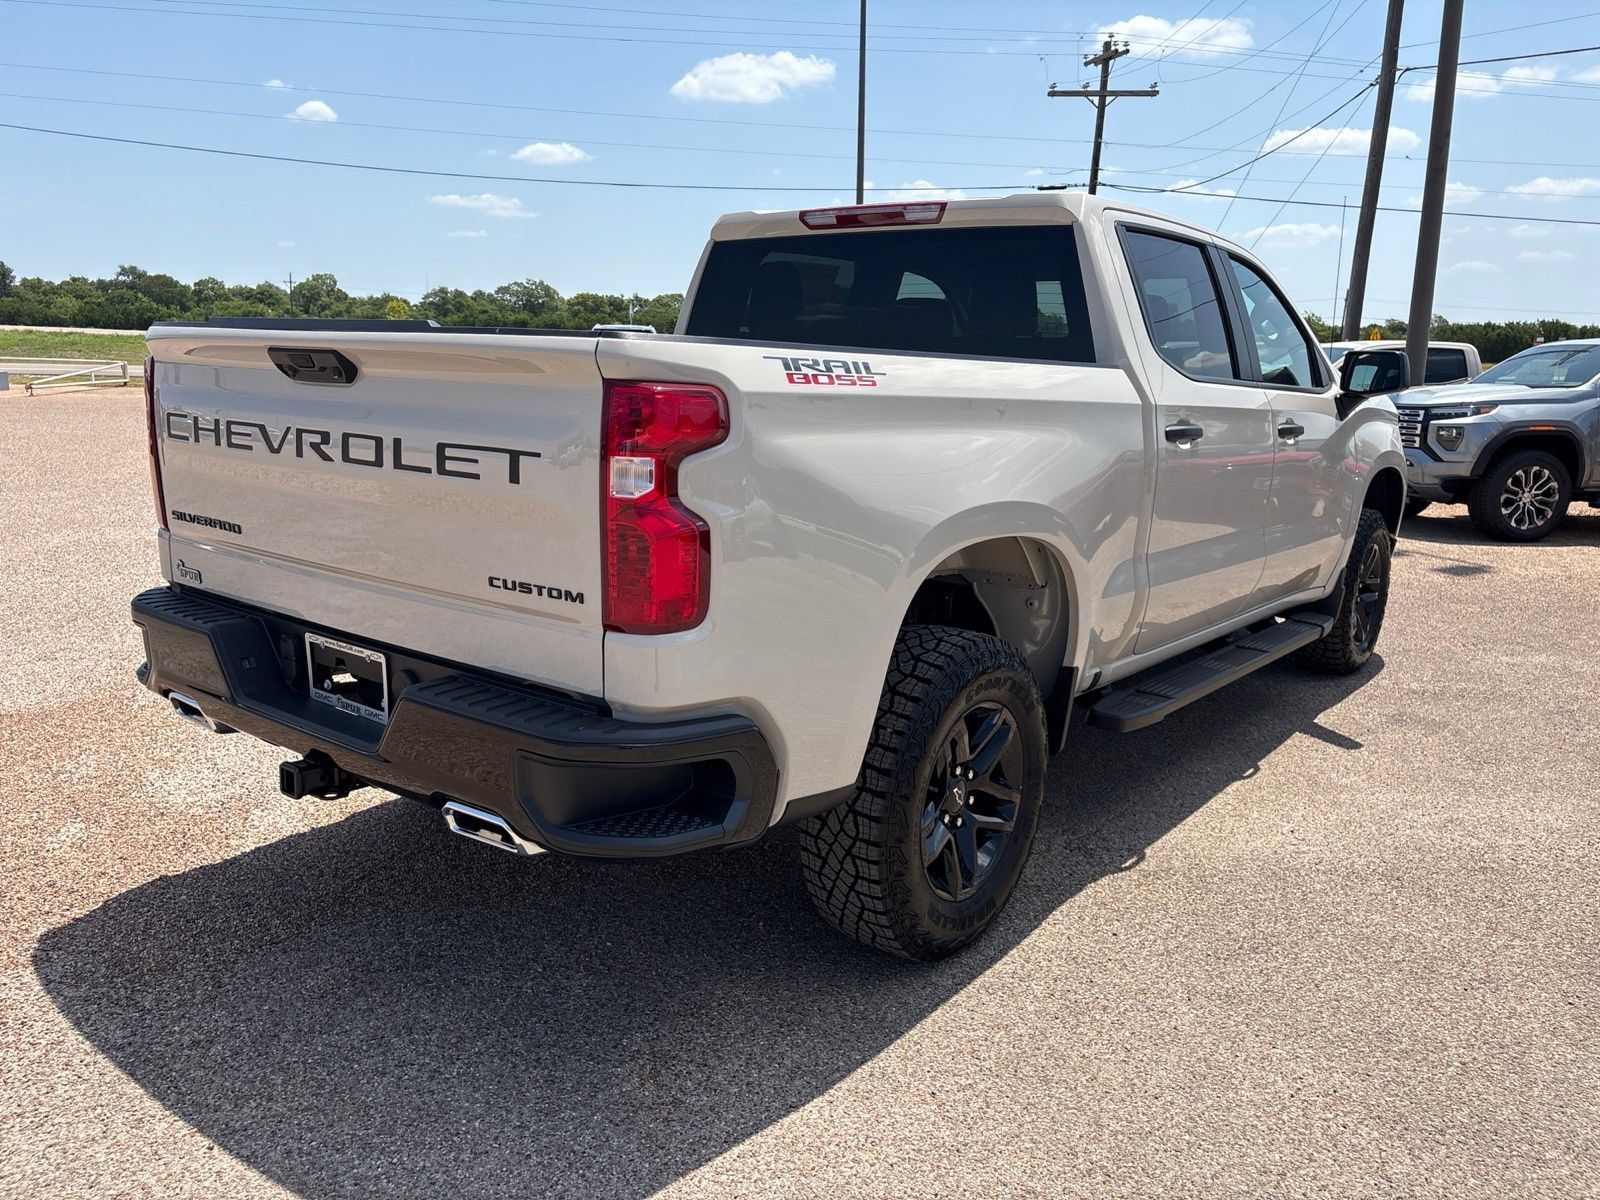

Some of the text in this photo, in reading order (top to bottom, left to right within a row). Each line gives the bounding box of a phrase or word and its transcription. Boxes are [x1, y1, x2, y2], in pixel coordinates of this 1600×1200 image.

[762, 356, 887, 376] TRAIL
[786, 373, 877, 387] BOSS
[165, 412, 542, 484] CHEVROLET
[171, 510, 242, 535] SILVERADO
[180, 568, 199, 581] SPUR
[488, 576, 585, 604] CUSTOM
[314, 691, 384, 721] GMC SPUR GMC
